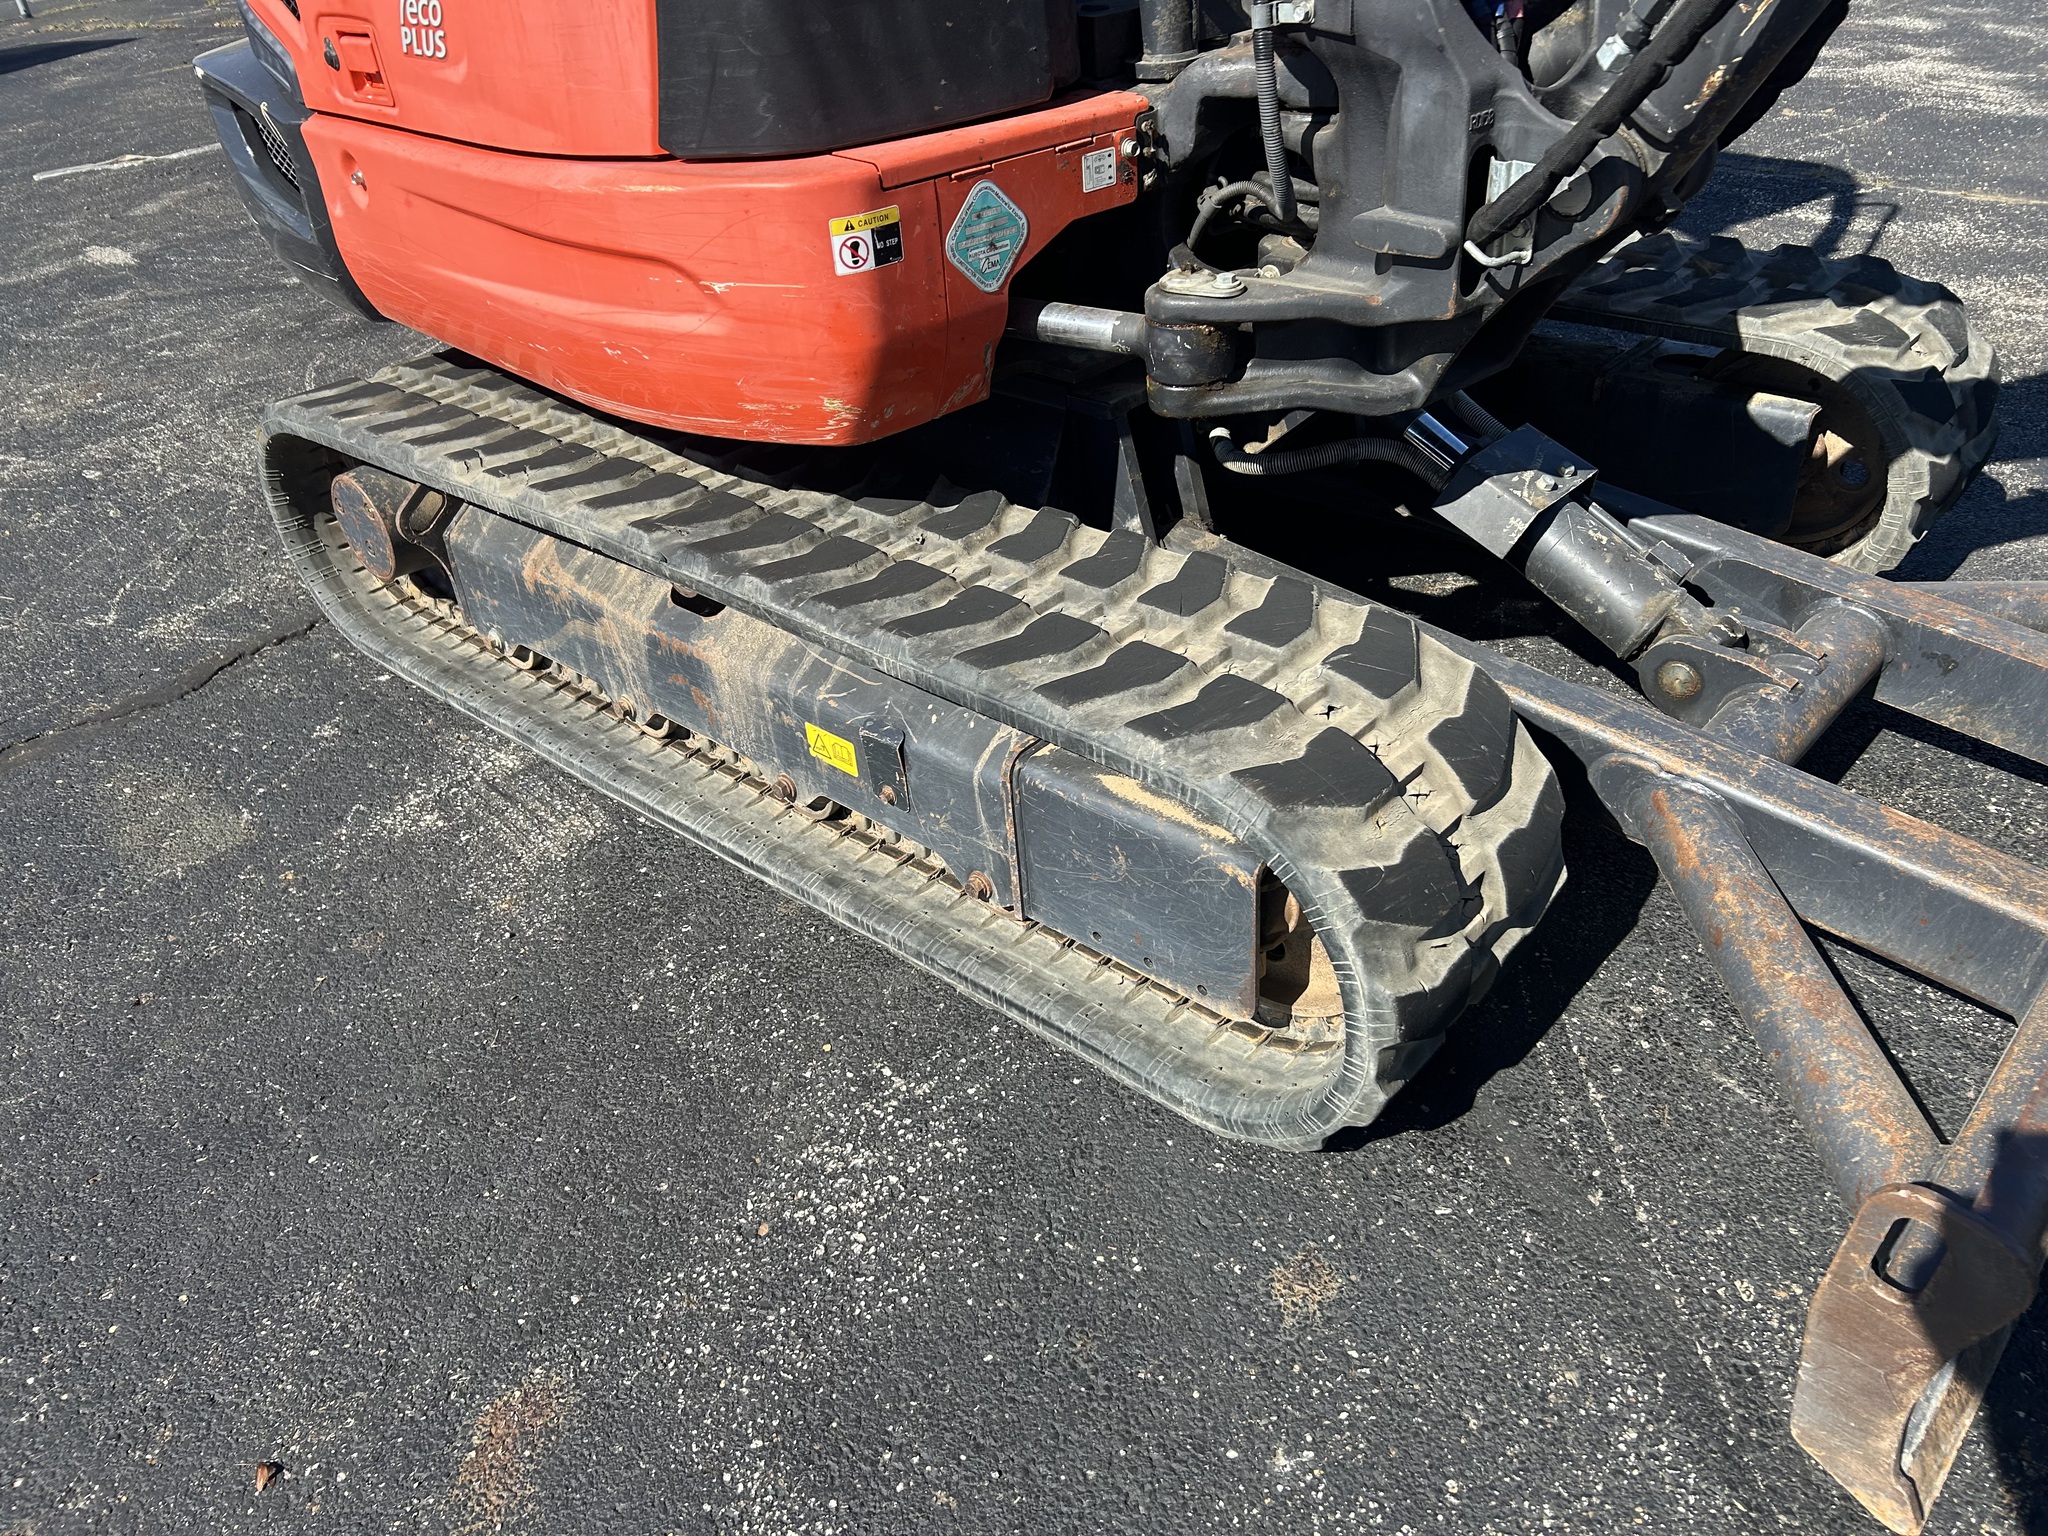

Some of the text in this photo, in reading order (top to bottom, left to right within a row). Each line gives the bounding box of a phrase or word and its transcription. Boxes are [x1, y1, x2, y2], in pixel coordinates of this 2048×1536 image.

[400, 26, 446, 58] PLUS
[858, 213, 889, 227] CAUTION
[886, 238, 898, 246] STEP
